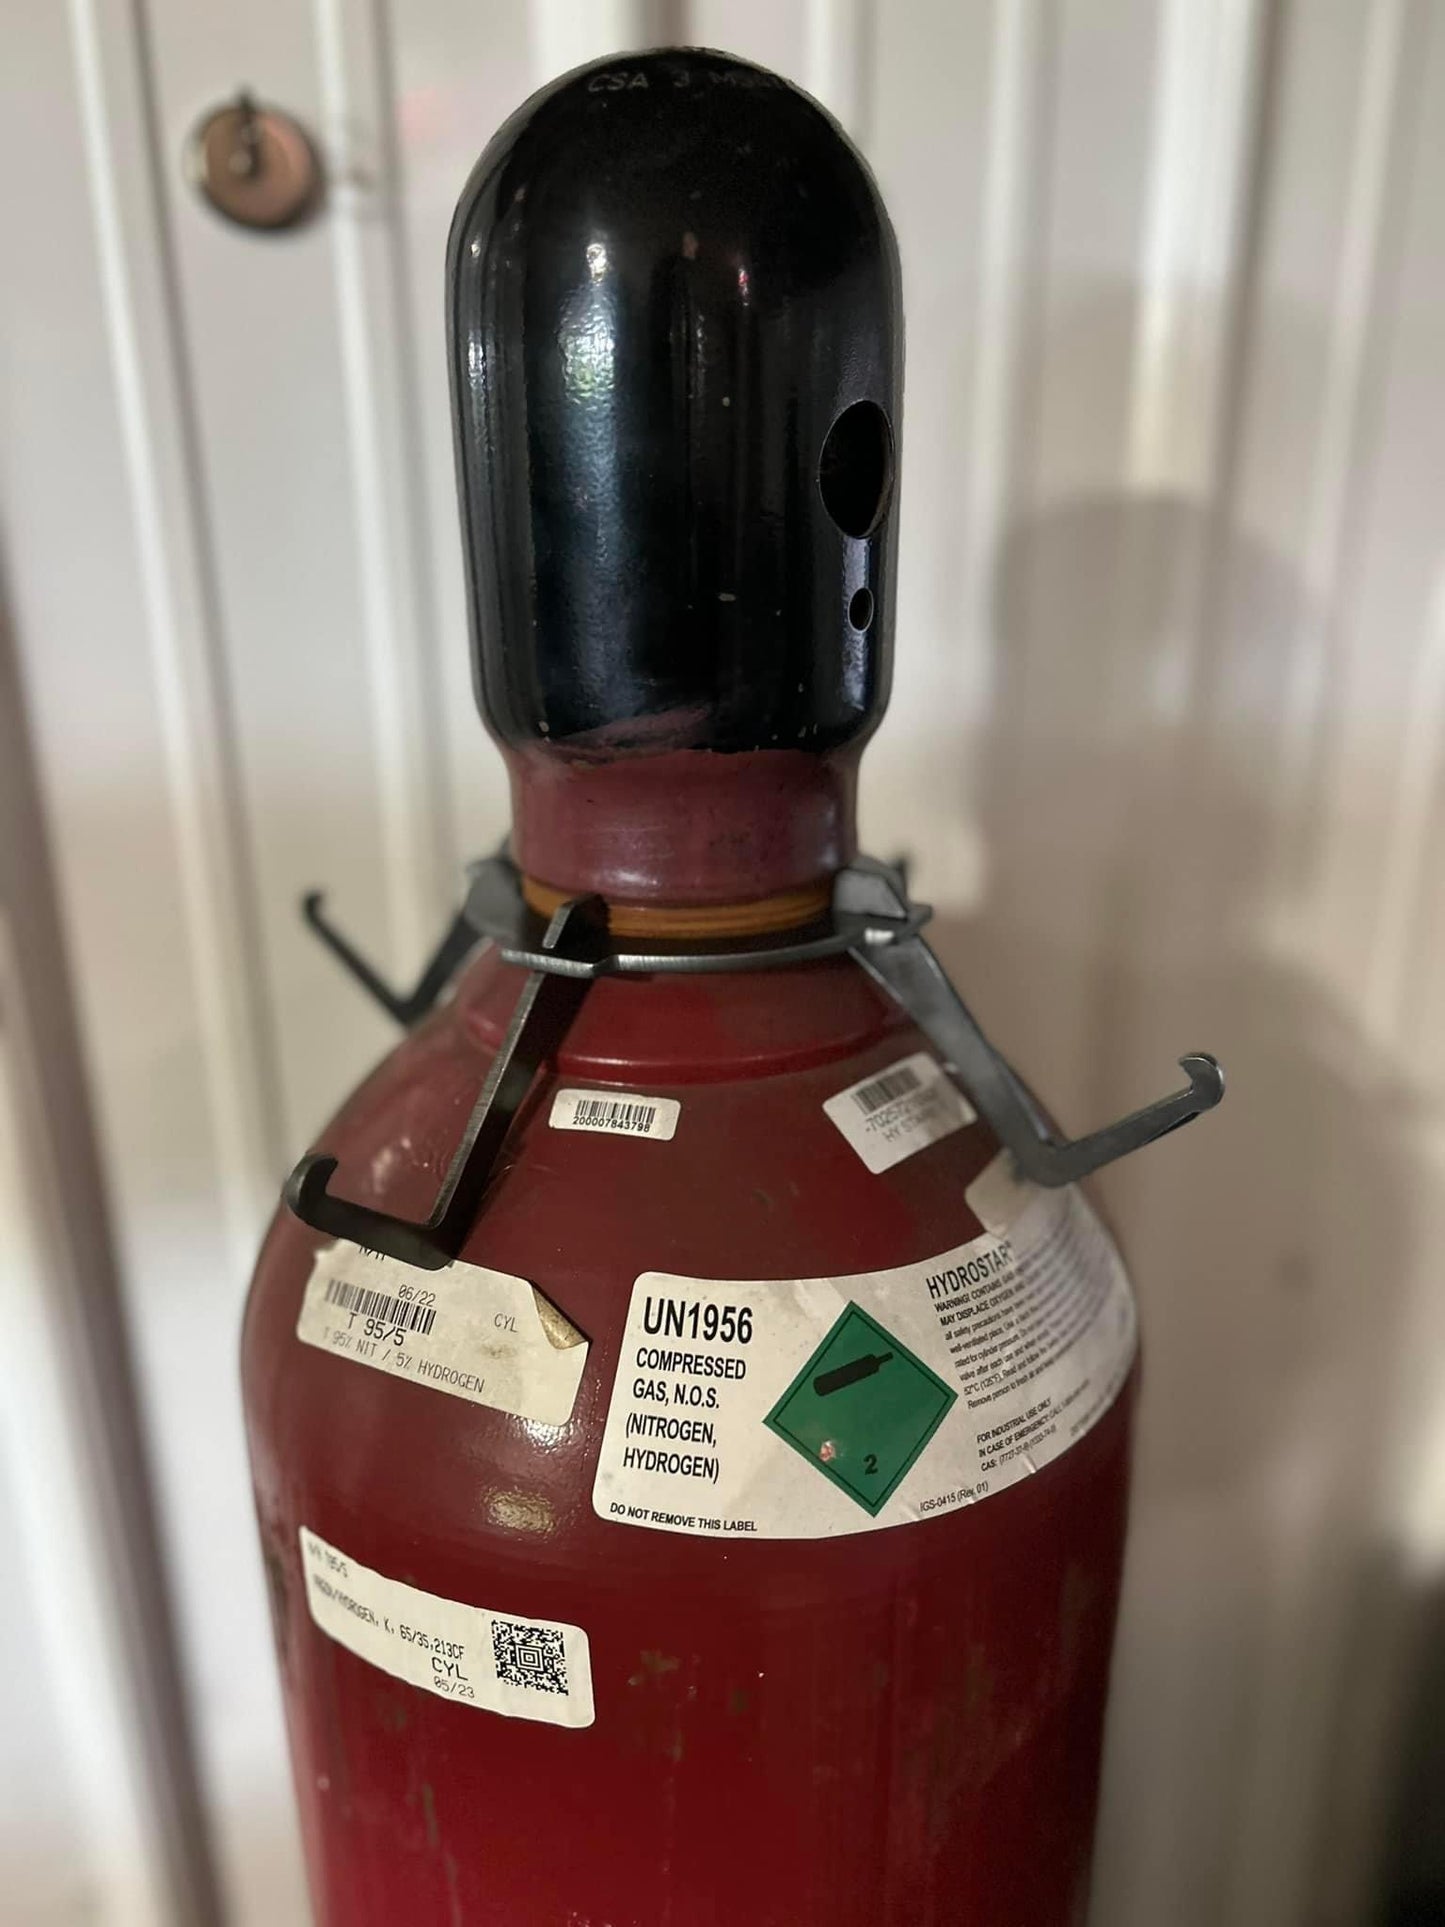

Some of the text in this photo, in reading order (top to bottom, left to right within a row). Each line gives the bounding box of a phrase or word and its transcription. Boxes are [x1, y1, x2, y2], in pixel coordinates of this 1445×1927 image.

[588, 72, 649, 93] CSA
[572, 1116, 651, 1133] 200007843798
[398, 1284, 437, 1308] 06/22
[493, 1312, 518, 1333] CYL
[643, 1296, 753, 1344] UN1956
[940, 1313, 955, 1326] MAY
[956, 1300, 989, 1320] DISPLACE
[363, 1318, 406, 1347] 95/5
[355, 1337, 377, 1356] NIT
[396, 1351, 413, 1371] 5%
[418, 1358, 486, 1394] HYDROGEN
[636, 1347, 747, 1380] COMPRESSED
[632, 1378, 720, 1409] GAS, N.O.S.
[968, 1394, 992, 1409] Remove
[626, 1412, 717, 1448] (NITROGEN,
[976, 1428, 992, 1444] FOR
[992, 1413, 1026, 1438] INDUSTRIAL
[1026, 1407, 1038, 1420] USE
[978, 1448, 987, 1458] IN
[987, 1441, 1005, 1456] CASE
[1005, 1436, 1015, 1447] OF
[623, 1446, 720, 1484] HYDROGEN)
[863, 1454, 878, 1475] 2
[981, 1459, 997, 1472] CAS:
[976, 1480, 989, 1496] 01)
[610, 1502, 758, 1532] DO NOT REMOVE THIS LABEL
[431, 1656, 469, 1682] CYL
[433, 1676, 476, 1699] 05/23
